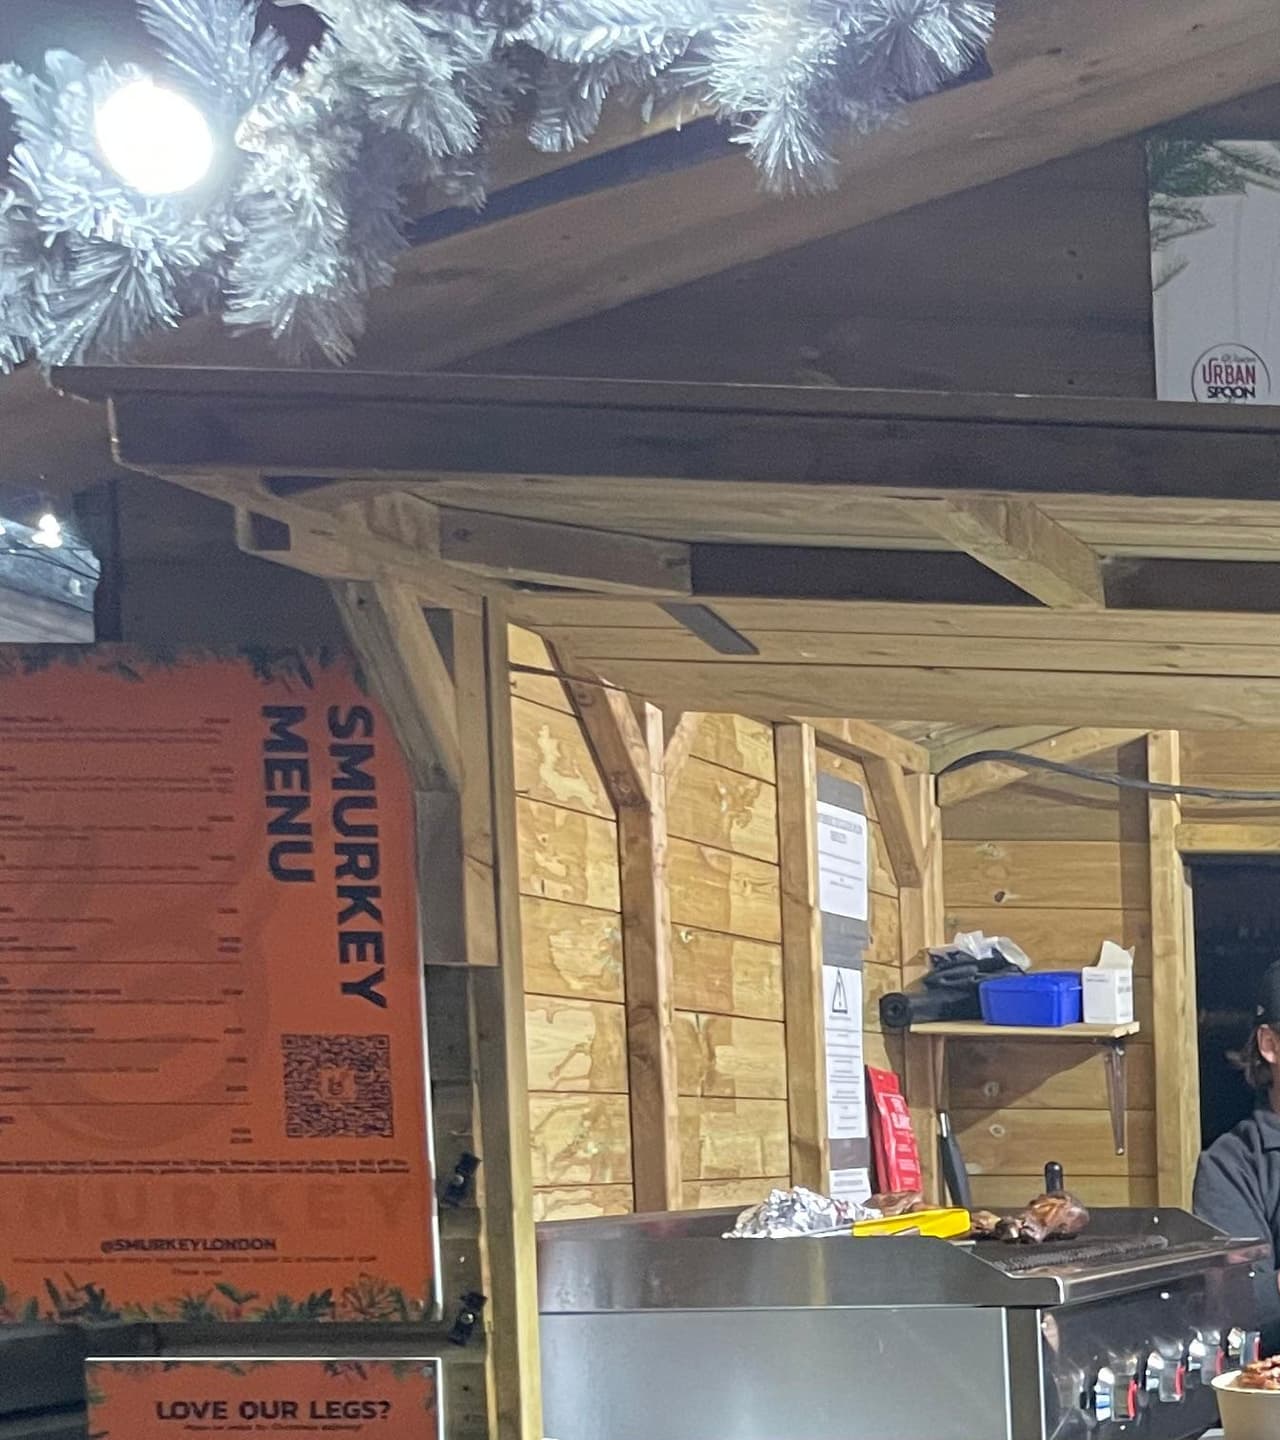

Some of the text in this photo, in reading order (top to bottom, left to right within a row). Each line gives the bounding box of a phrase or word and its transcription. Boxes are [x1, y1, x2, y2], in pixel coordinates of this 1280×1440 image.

[1202, 357, 1256, 385] URBAN
[1207, 386, 1256, 399] SPOON
[261, 705, 315, 883] MENU
[327, 705, 387, 1009] SMURKEY
[101, 1238, 277, 1255] @SMURKEYLONDON
[156, 1399, 391, 1421] LOVE OUR LEGS?
